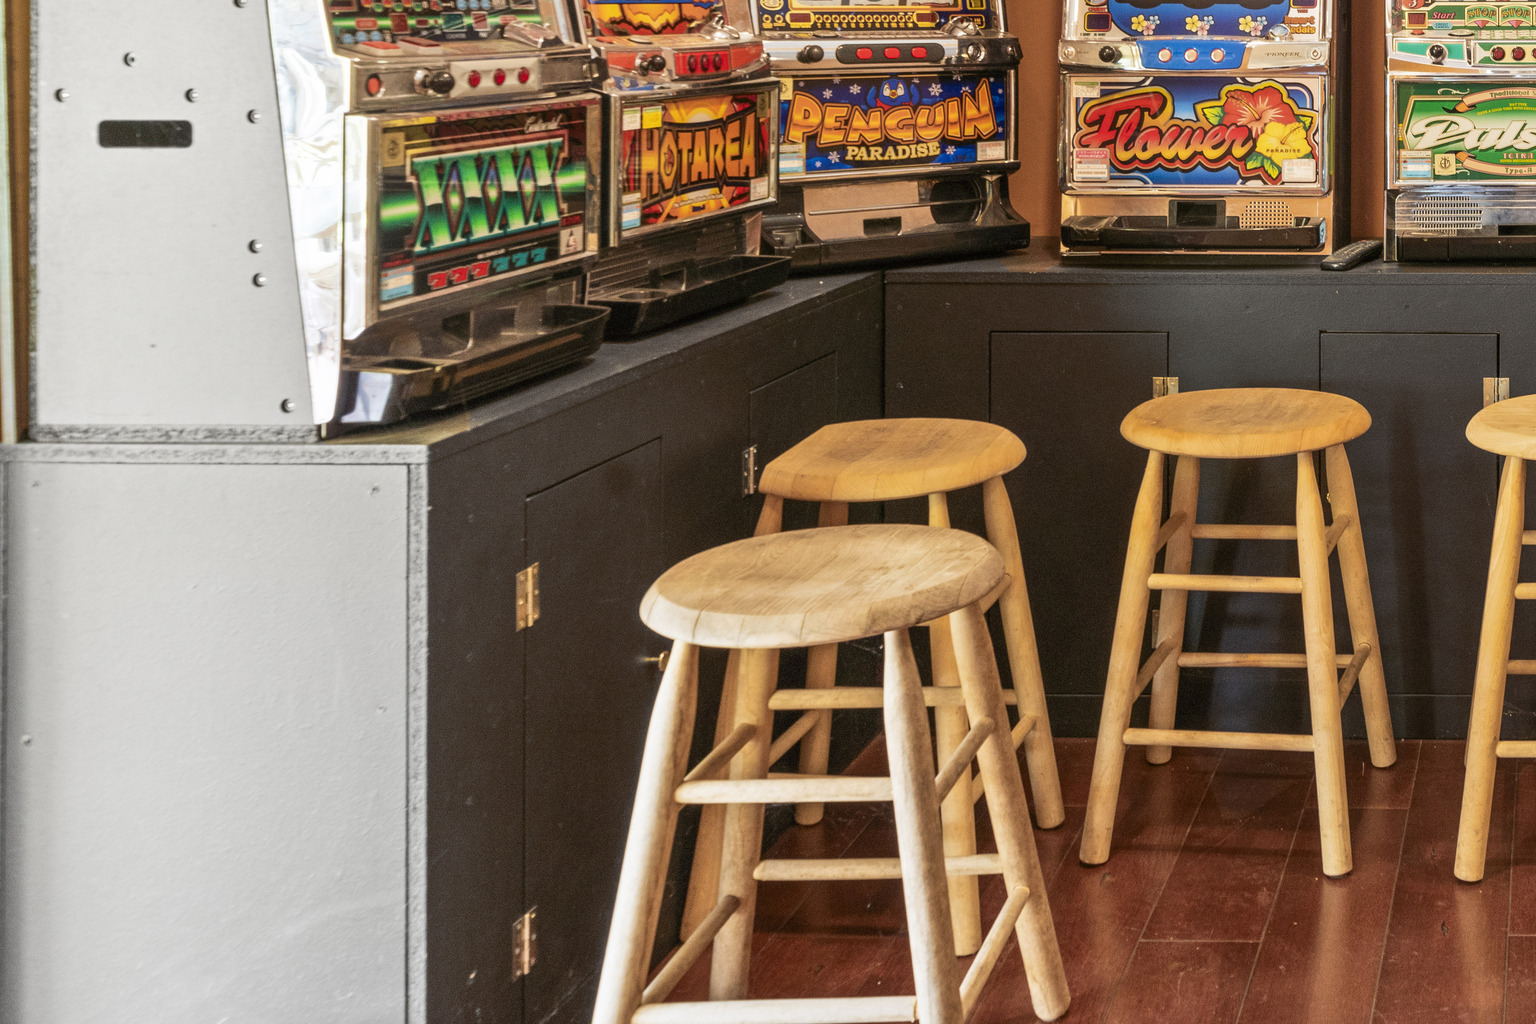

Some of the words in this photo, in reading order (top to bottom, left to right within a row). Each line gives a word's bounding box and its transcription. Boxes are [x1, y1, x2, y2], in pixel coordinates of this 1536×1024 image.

[1432, 11, 1456, 20] Start
[1467, 7, 1496, 19] STOP
[1501, 7, 1531, 19] STOP
[785, 79, 998, 146] PENGUIN
[1079, 91, 1255, 163] Flower
[845, 141, 941, 161] PARADISE
